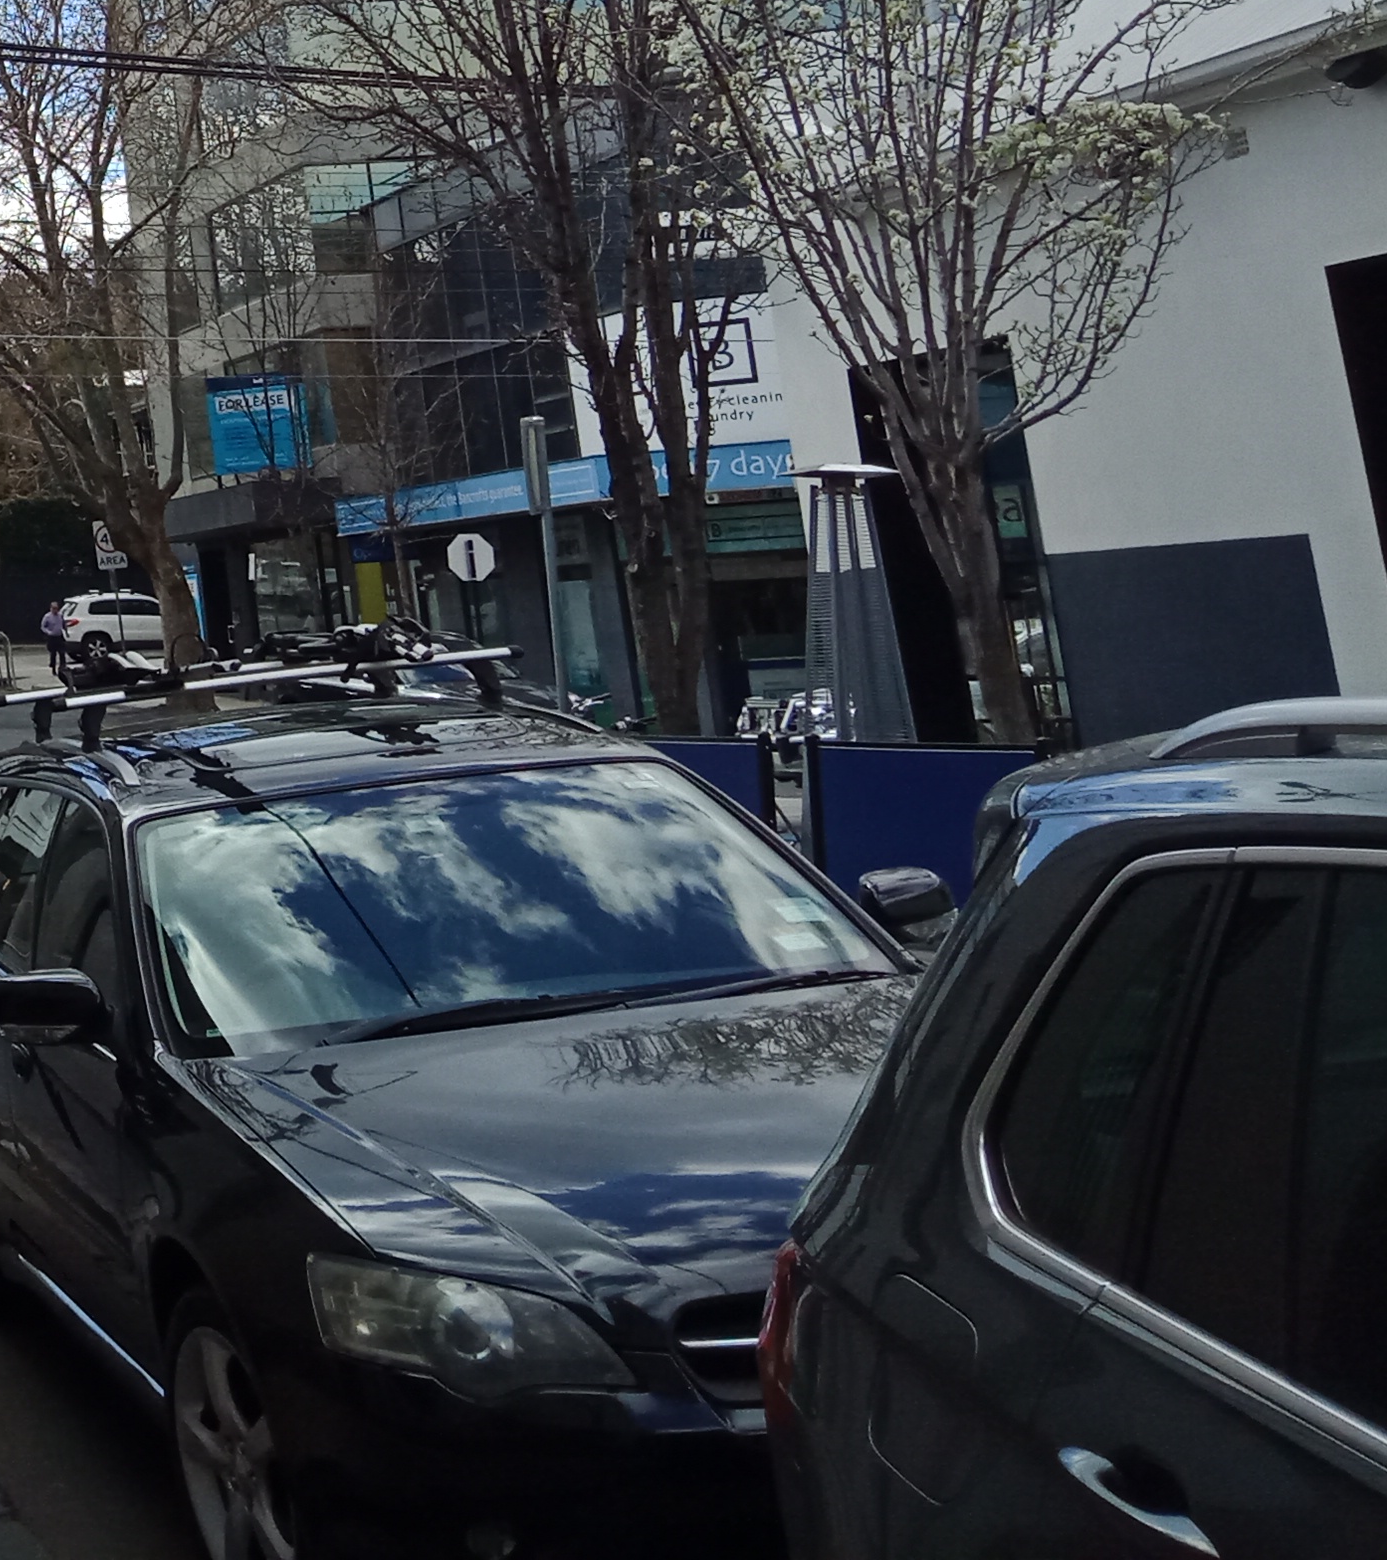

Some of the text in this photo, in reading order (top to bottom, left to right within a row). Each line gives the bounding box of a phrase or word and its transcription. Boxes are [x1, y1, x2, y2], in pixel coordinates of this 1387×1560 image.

[218, 394, 285, 412] FOR LEASE
[100, 556, 126, 566] AREA
